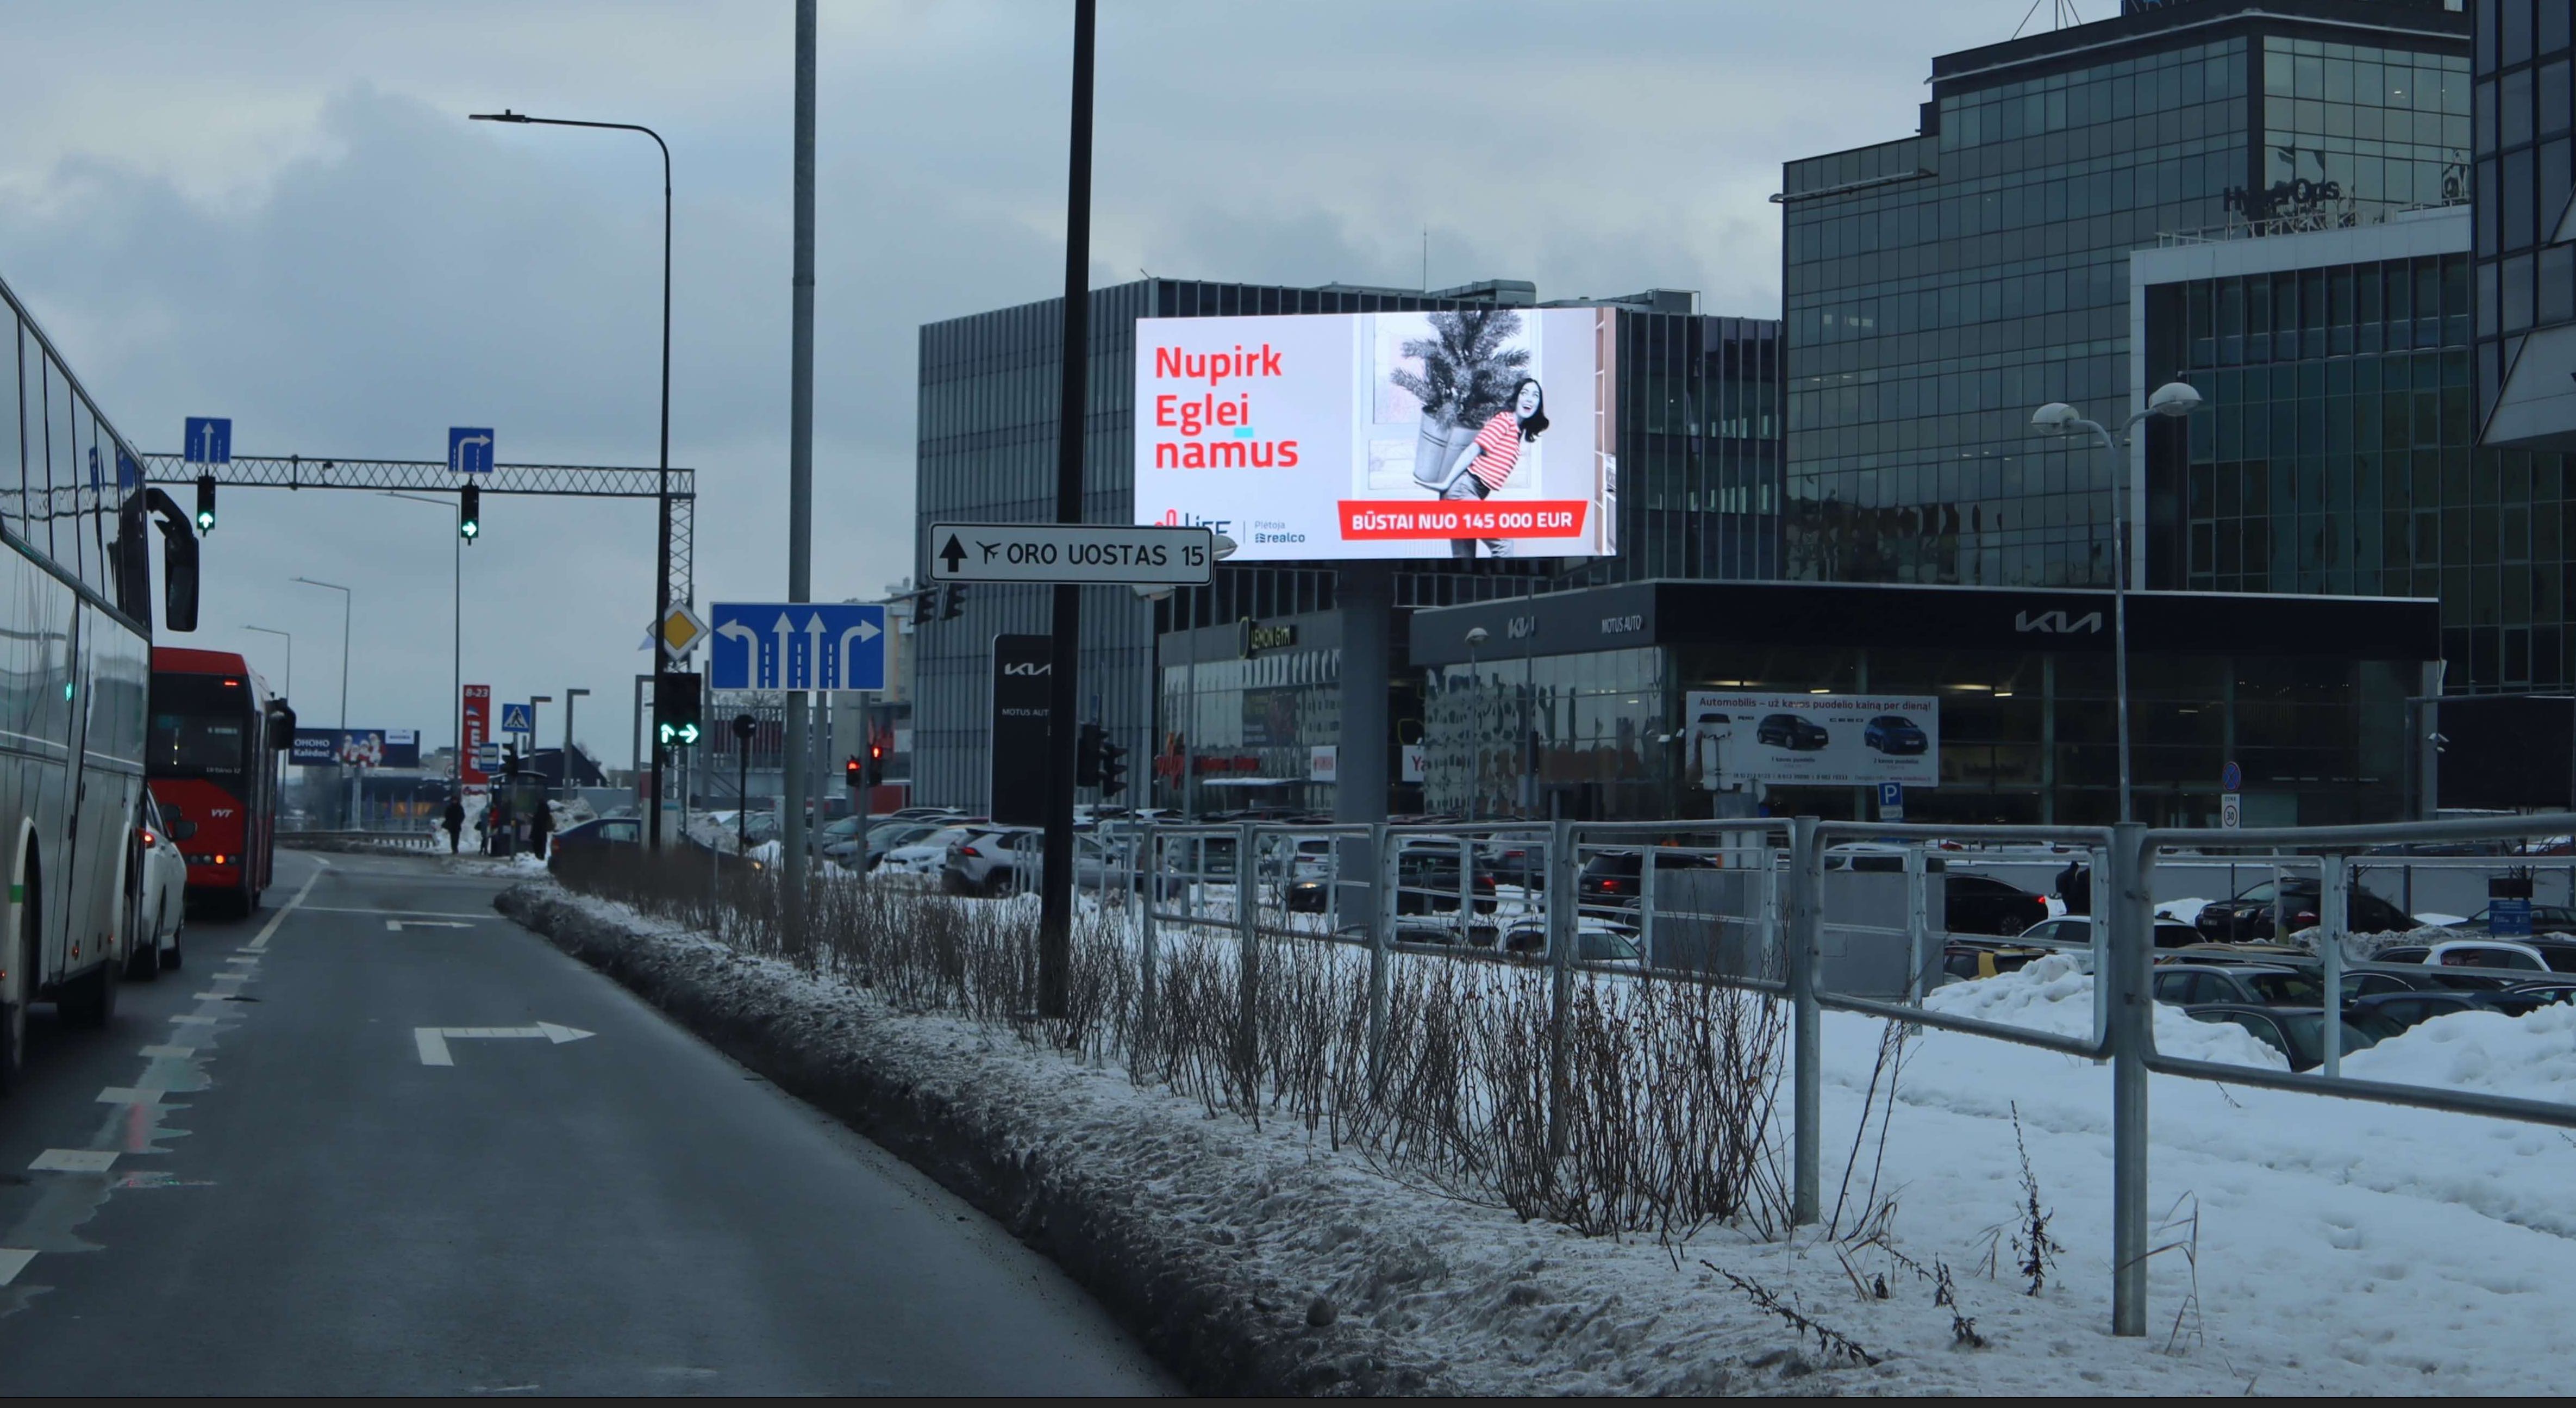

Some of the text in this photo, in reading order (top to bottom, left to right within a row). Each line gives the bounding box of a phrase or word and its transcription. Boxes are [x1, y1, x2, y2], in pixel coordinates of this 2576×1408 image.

[1156, 344, 1282, 387] Nupirk
[1156, 393, 1248, 437] Eglei
[1156, 440, 1299, 469] namus
[1352, 510, 1572, 531] BŪSTAI NUO 145 000 EUR
[1267, 532, 1305, 543] realco
[1007, 543, 1204, 567] ORO UOSTAS 15
[1602, 615, 1642, 634] MOTUS AUTO
[465, 688, 489, 697] 8-23
[1002, 708, 1051, 717] MOTUS AUT
[1699, 697, 1756, 707] Automobilis
[1812, 700, 1853, 710] puodelio
[1884, 702, 1899, 711] per
[294, 738, 330, 747] OHOHO
[1884, 784, 1897, 804] P
[2226, 812, 2235, 821] 30
